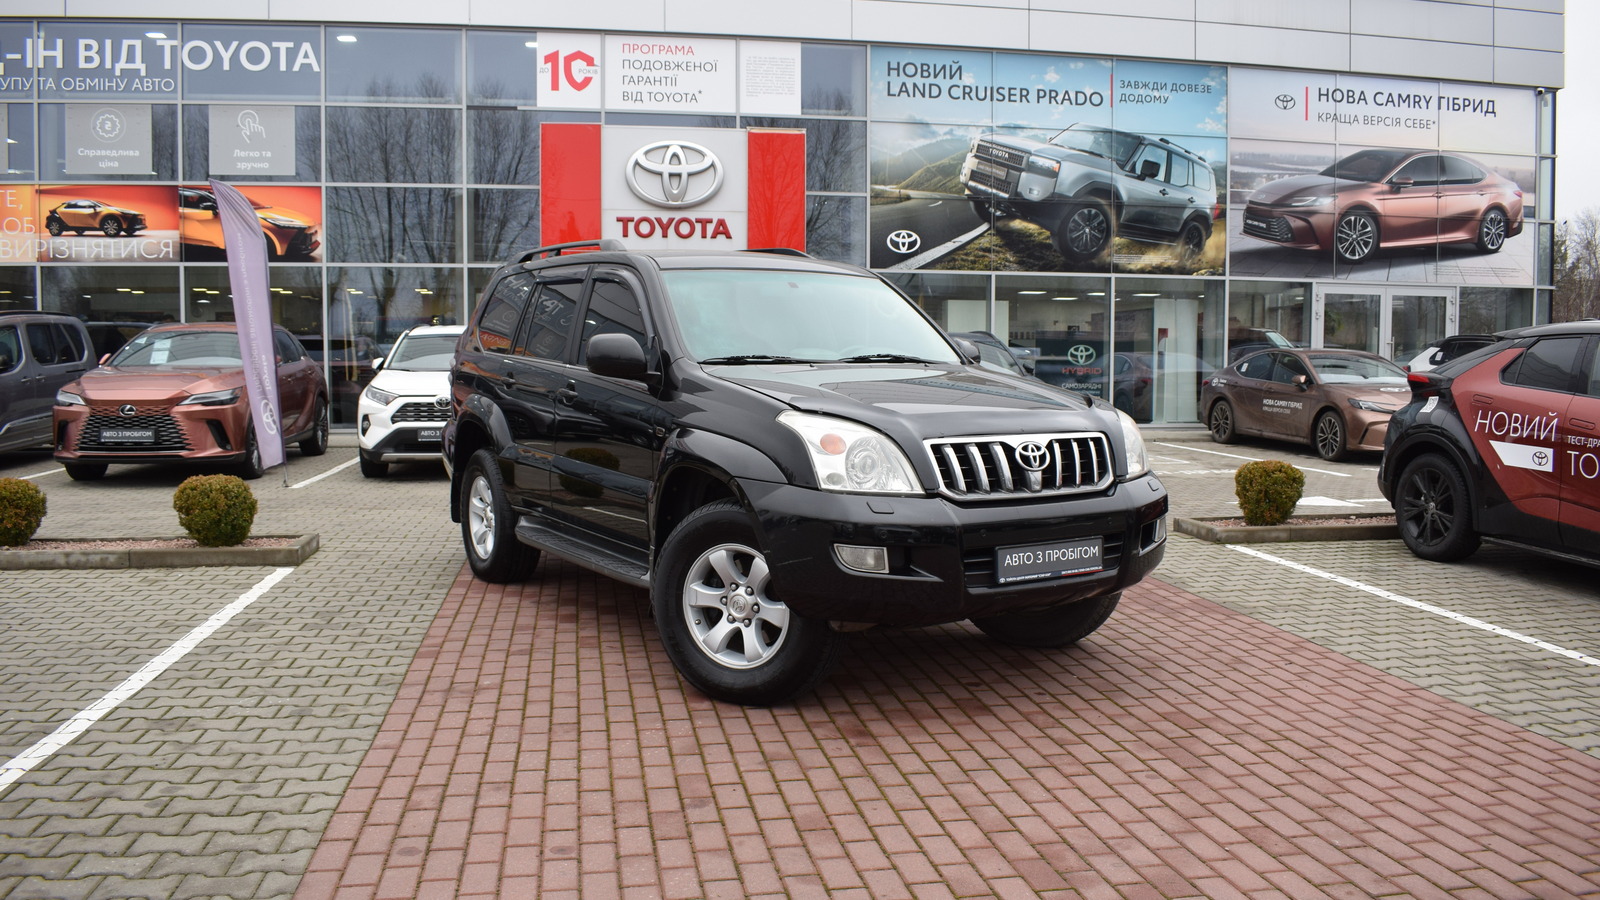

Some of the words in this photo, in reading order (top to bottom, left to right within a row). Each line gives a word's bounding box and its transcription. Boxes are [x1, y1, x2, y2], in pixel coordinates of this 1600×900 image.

[622, 43, 695, 56] ПРОГРАМА
[78, 39, 146, 76] ВІД
[156, 40, 320, 72] TOYOTA
[622, 59, 719, 72] ПОДОВЖЕНОЇ
[887, 60, 963, 81] НОВИЙ
[38, 78, 56, 90] ТА
[61, 78, 128, 91] ОБМІНУ
[131, 79, 175, 92] АВТО
[622, 74, 679, 87] ГАРАНТІЇ
[1119, 80, 1168, 92] ЗАВЖДИ
[1170, 83, 1212, 94] ДОВЕЗЕ
[622, 91, 644, 104] ВІД
[887, 81, 942, 99] LAND
[948, 84, 1031, 104] CRUISER
[1036, 89, 1104, 107] PRADO
[1119, 93, 1169, 104] ДОДОМУ
[1318, 87, 1368, 105] НОВА
[1373, 92, 1433, 110] CAMRY
[1437, 96, 1497, 117] ГІБРИД
[1317, 112, 1359, 126] КРАЩА
[1363, 115, 1401, 127] ВЕРСІЯ
[78, 147, 140, 157] Справедлива
[233, 149, 260, 158] Легко
[989, 148, 1009, 159] TOYOTA
[98, 159, 119, 169] ціна
[236, 162, 269, 170] зручно
[616, 216, 733, 240] TOYOTA
[0, 239, 173, 258] ВИРІЗНЯТИСЯ
[1062, 367, 1102, 375] HYBRID
[1474, 410, 1558, 442] НОВИЙ
[1004, 552, 1034, 567] АВТО
[1036, 551, 1043, 563] З
[1045, 545, 1099, 562] ПРОБІГОМ
